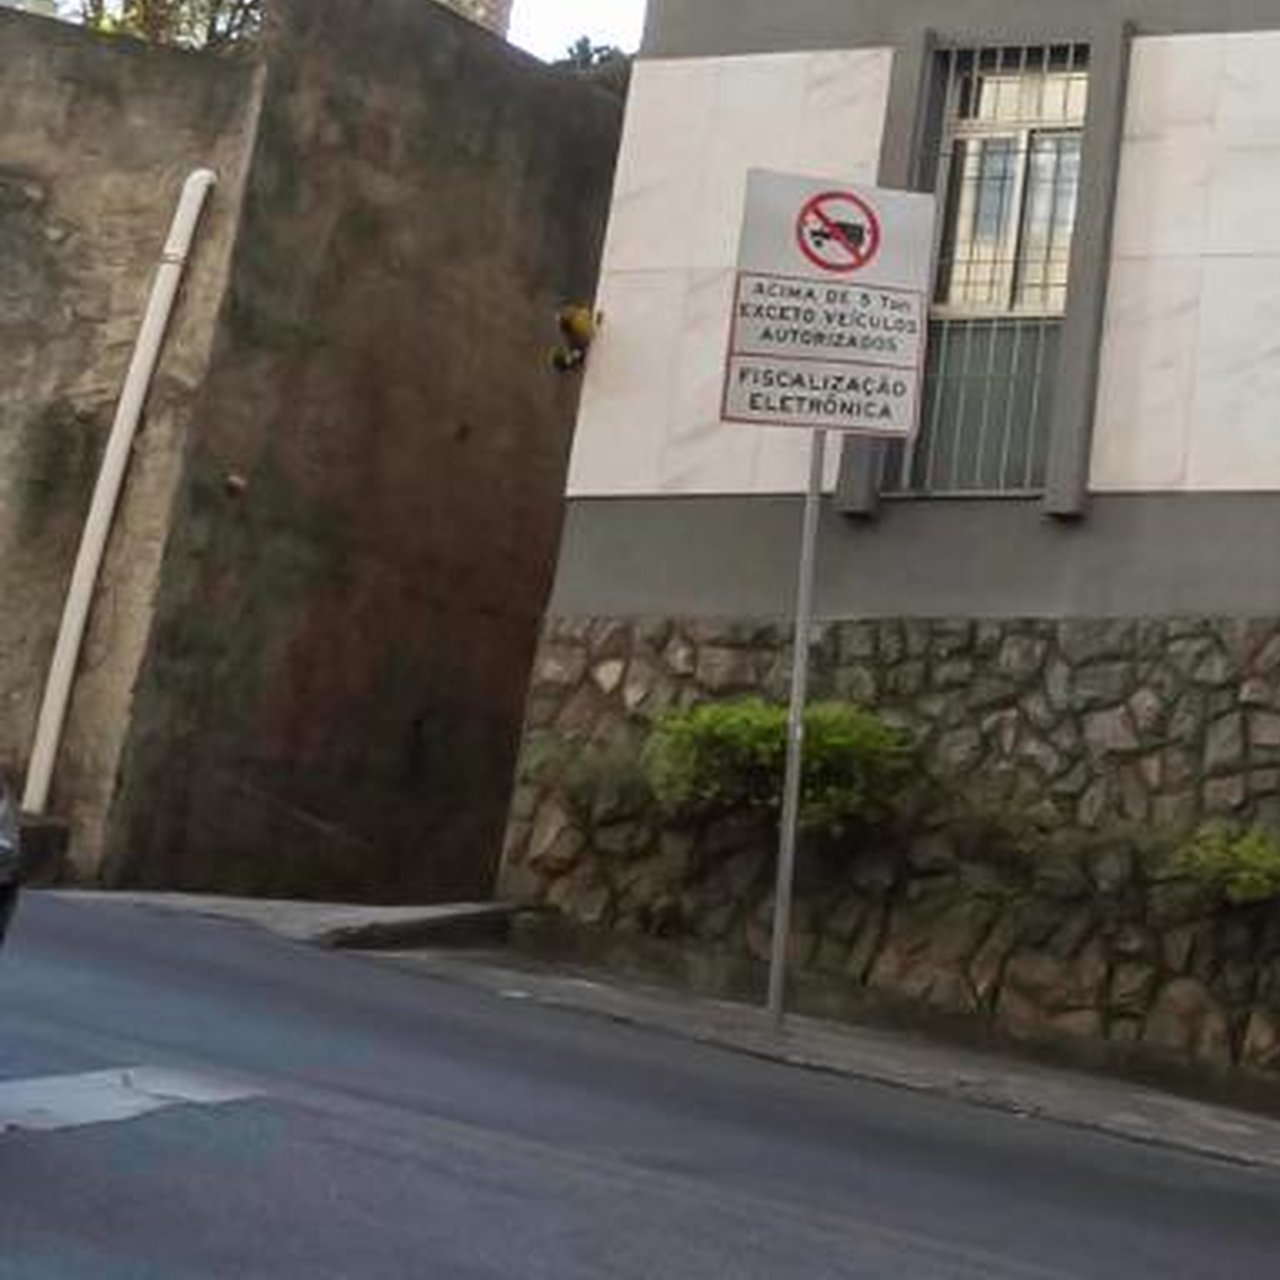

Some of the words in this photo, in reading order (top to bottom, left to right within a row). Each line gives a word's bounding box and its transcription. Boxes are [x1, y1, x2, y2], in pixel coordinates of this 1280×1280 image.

[753, 282, 816, 300] ACIMA
[825, 289, 849, 304] DE
[738, 302, 815, 323] EXCETO
[824, 306, 917, 333] VEÍCULOS
[761, 325, 897, 352] AUTORIZADOS
[738, 368, 906, 397] FISCALIZAÇÃO
[748, 393, 892, 419] ELETRÔNICA
